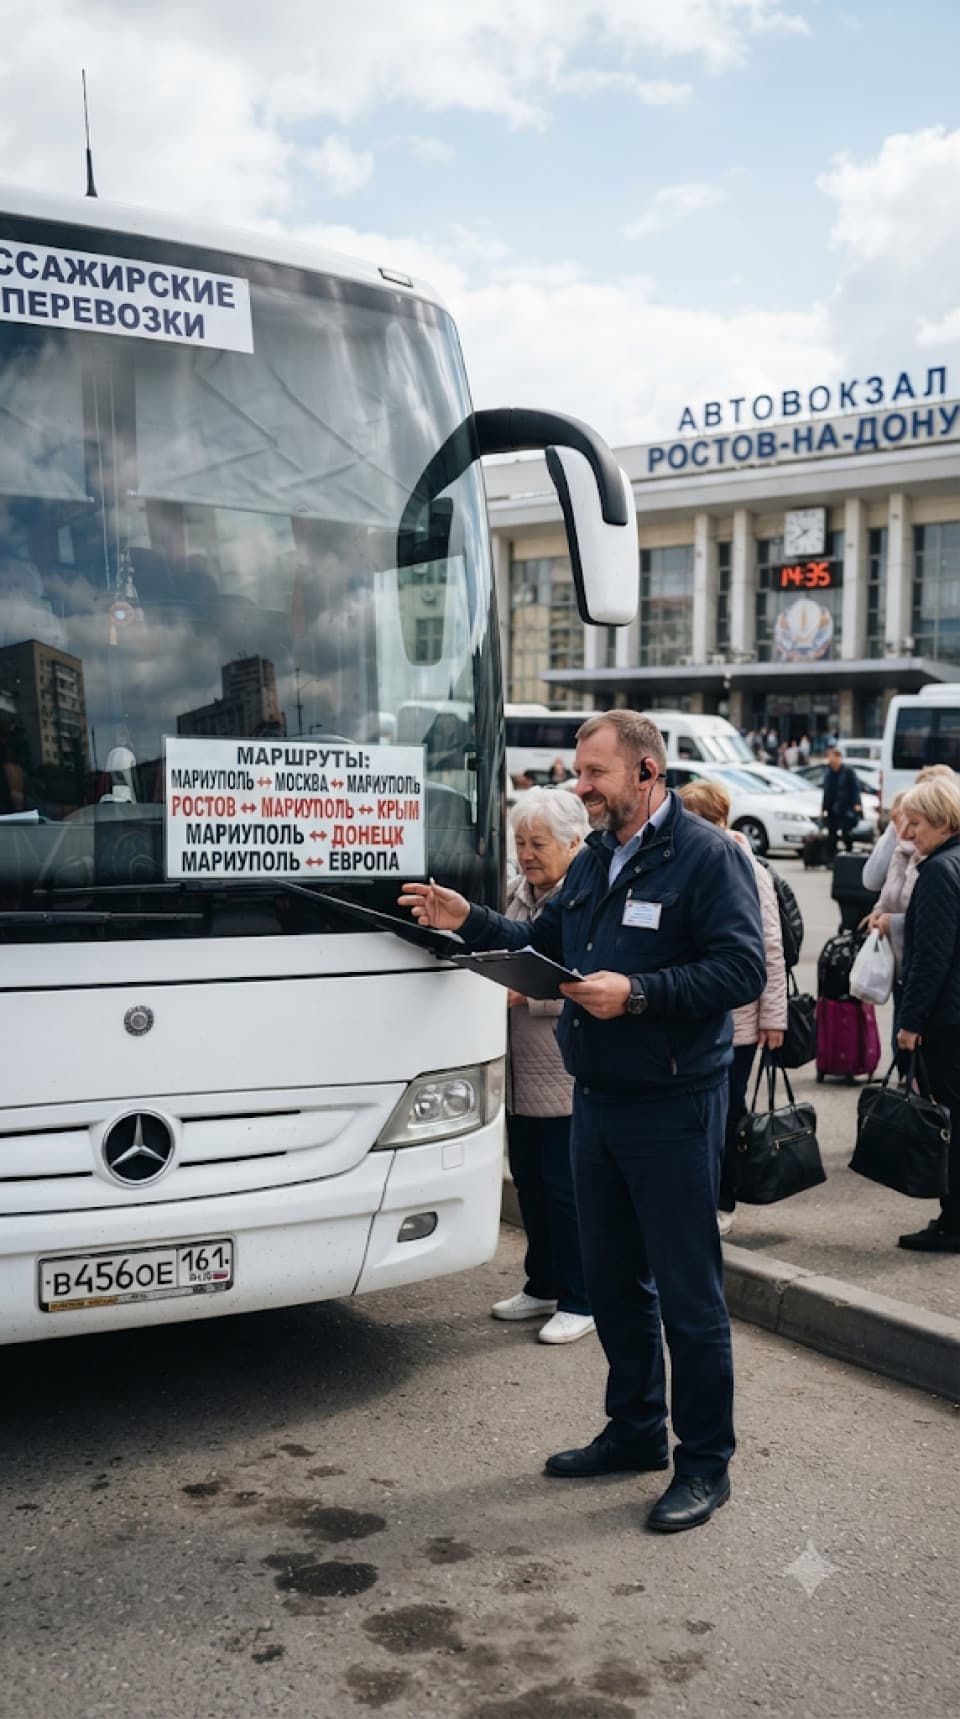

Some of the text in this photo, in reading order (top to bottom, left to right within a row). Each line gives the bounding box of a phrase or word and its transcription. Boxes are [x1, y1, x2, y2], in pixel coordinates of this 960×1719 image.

[2, 286, 205, 339] ПЕРЕВОЗКИ
[678, 365, 947, 431] АВТОВОКЗАЛ
[647, 404, 960, 473] РОСТОВ-НА-ДОНУ
[780, 561, 832, 588] 14:35
[236, 746, 370, 768] МАРШРУТЫ:
[170, 768, 255, 791] МАРИУПОЛЬ
[275, 771, 329, 792] МОСКВА
[171, 795, 419, 820] РОСТОВ МАРИУПОЛЬ КРЫМ
[185, 823, 404, 849] МАРИУПОЛЬ ДОНЕЦК
[181, 850, 400, 873] МАРИУПОЛЬ ЕВРОПА
[180, 1246, 224, 1272] 161
